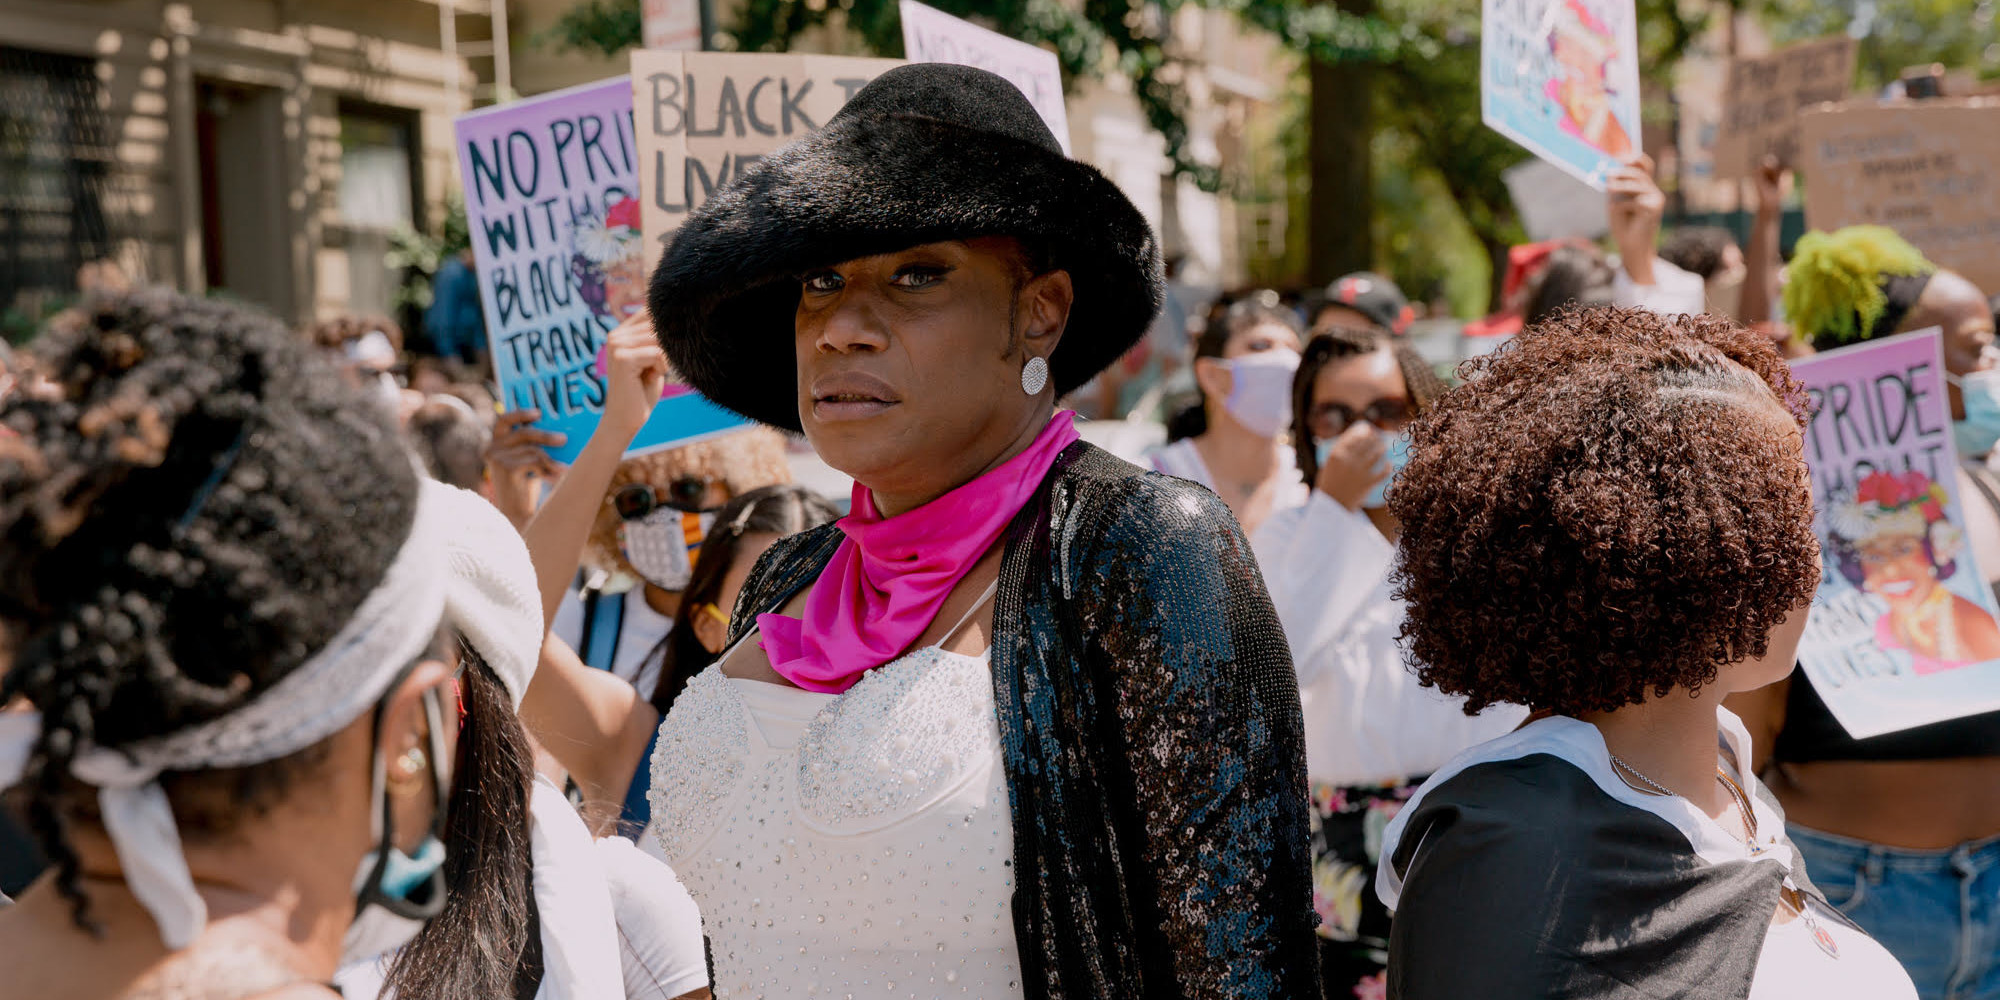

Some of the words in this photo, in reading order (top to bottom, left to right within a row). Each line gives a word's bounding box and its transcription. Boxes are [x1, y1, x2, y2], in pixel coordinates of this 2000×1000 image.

[648, 72, 822, 137] BLACK
[468, 130, 539, 207] NO
[549, 109, 635, 188] PRI
[512, 362, 607, 414] LIVES
[1806, 361, 1944, 460] PRIDE
